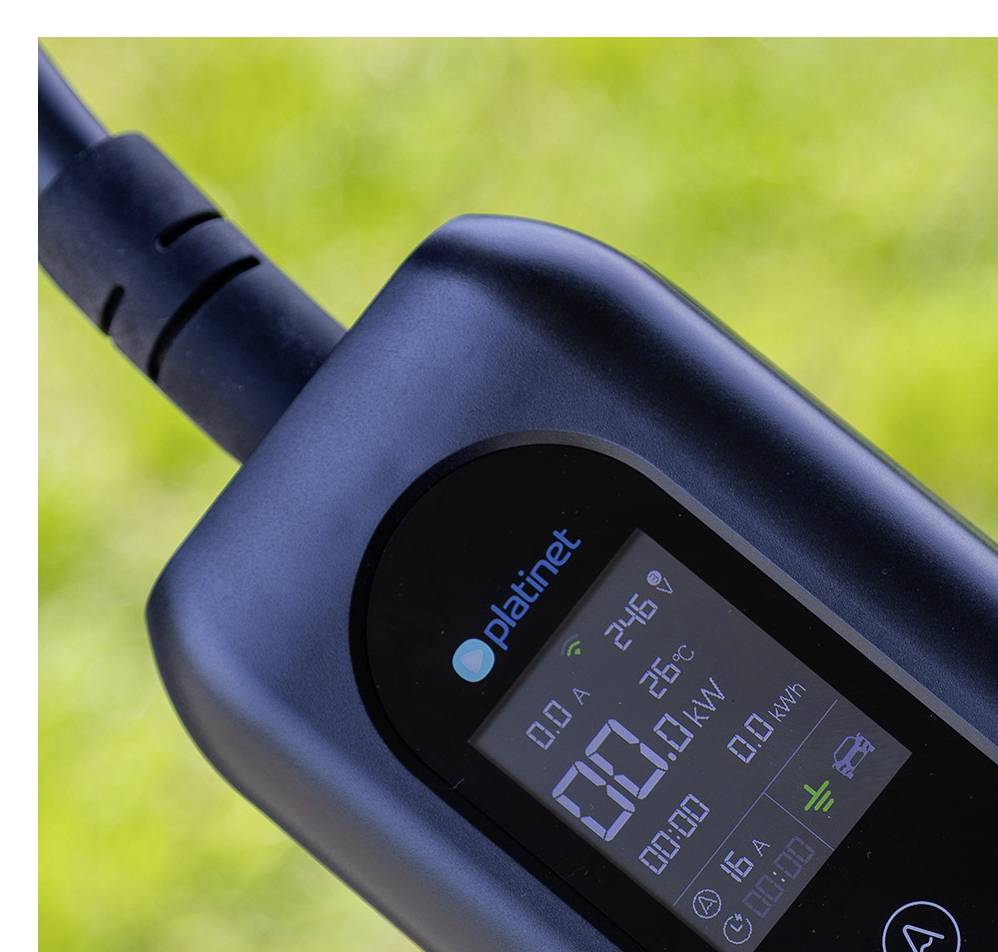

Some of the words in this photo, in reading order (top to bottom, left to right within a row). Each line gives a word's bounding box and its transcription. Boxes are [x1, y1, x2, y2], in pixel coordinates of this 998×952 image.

[484, 528, 582, 651] platinet
[605, 593, 657, 651] 246
[527, 699, 572, 750] 0.0
[573, 688, 591, 706] A
[552, 713, 694, 841] 00.0
[682, 678, 725, 728] kW
[728, 713, 774, 764] 0.0
[769, 682, 807, 723] kWh
[639, 793, 710, 875] 00:00
[720, 850, 753, 883] 16
[752, 839, 770, 857] A
